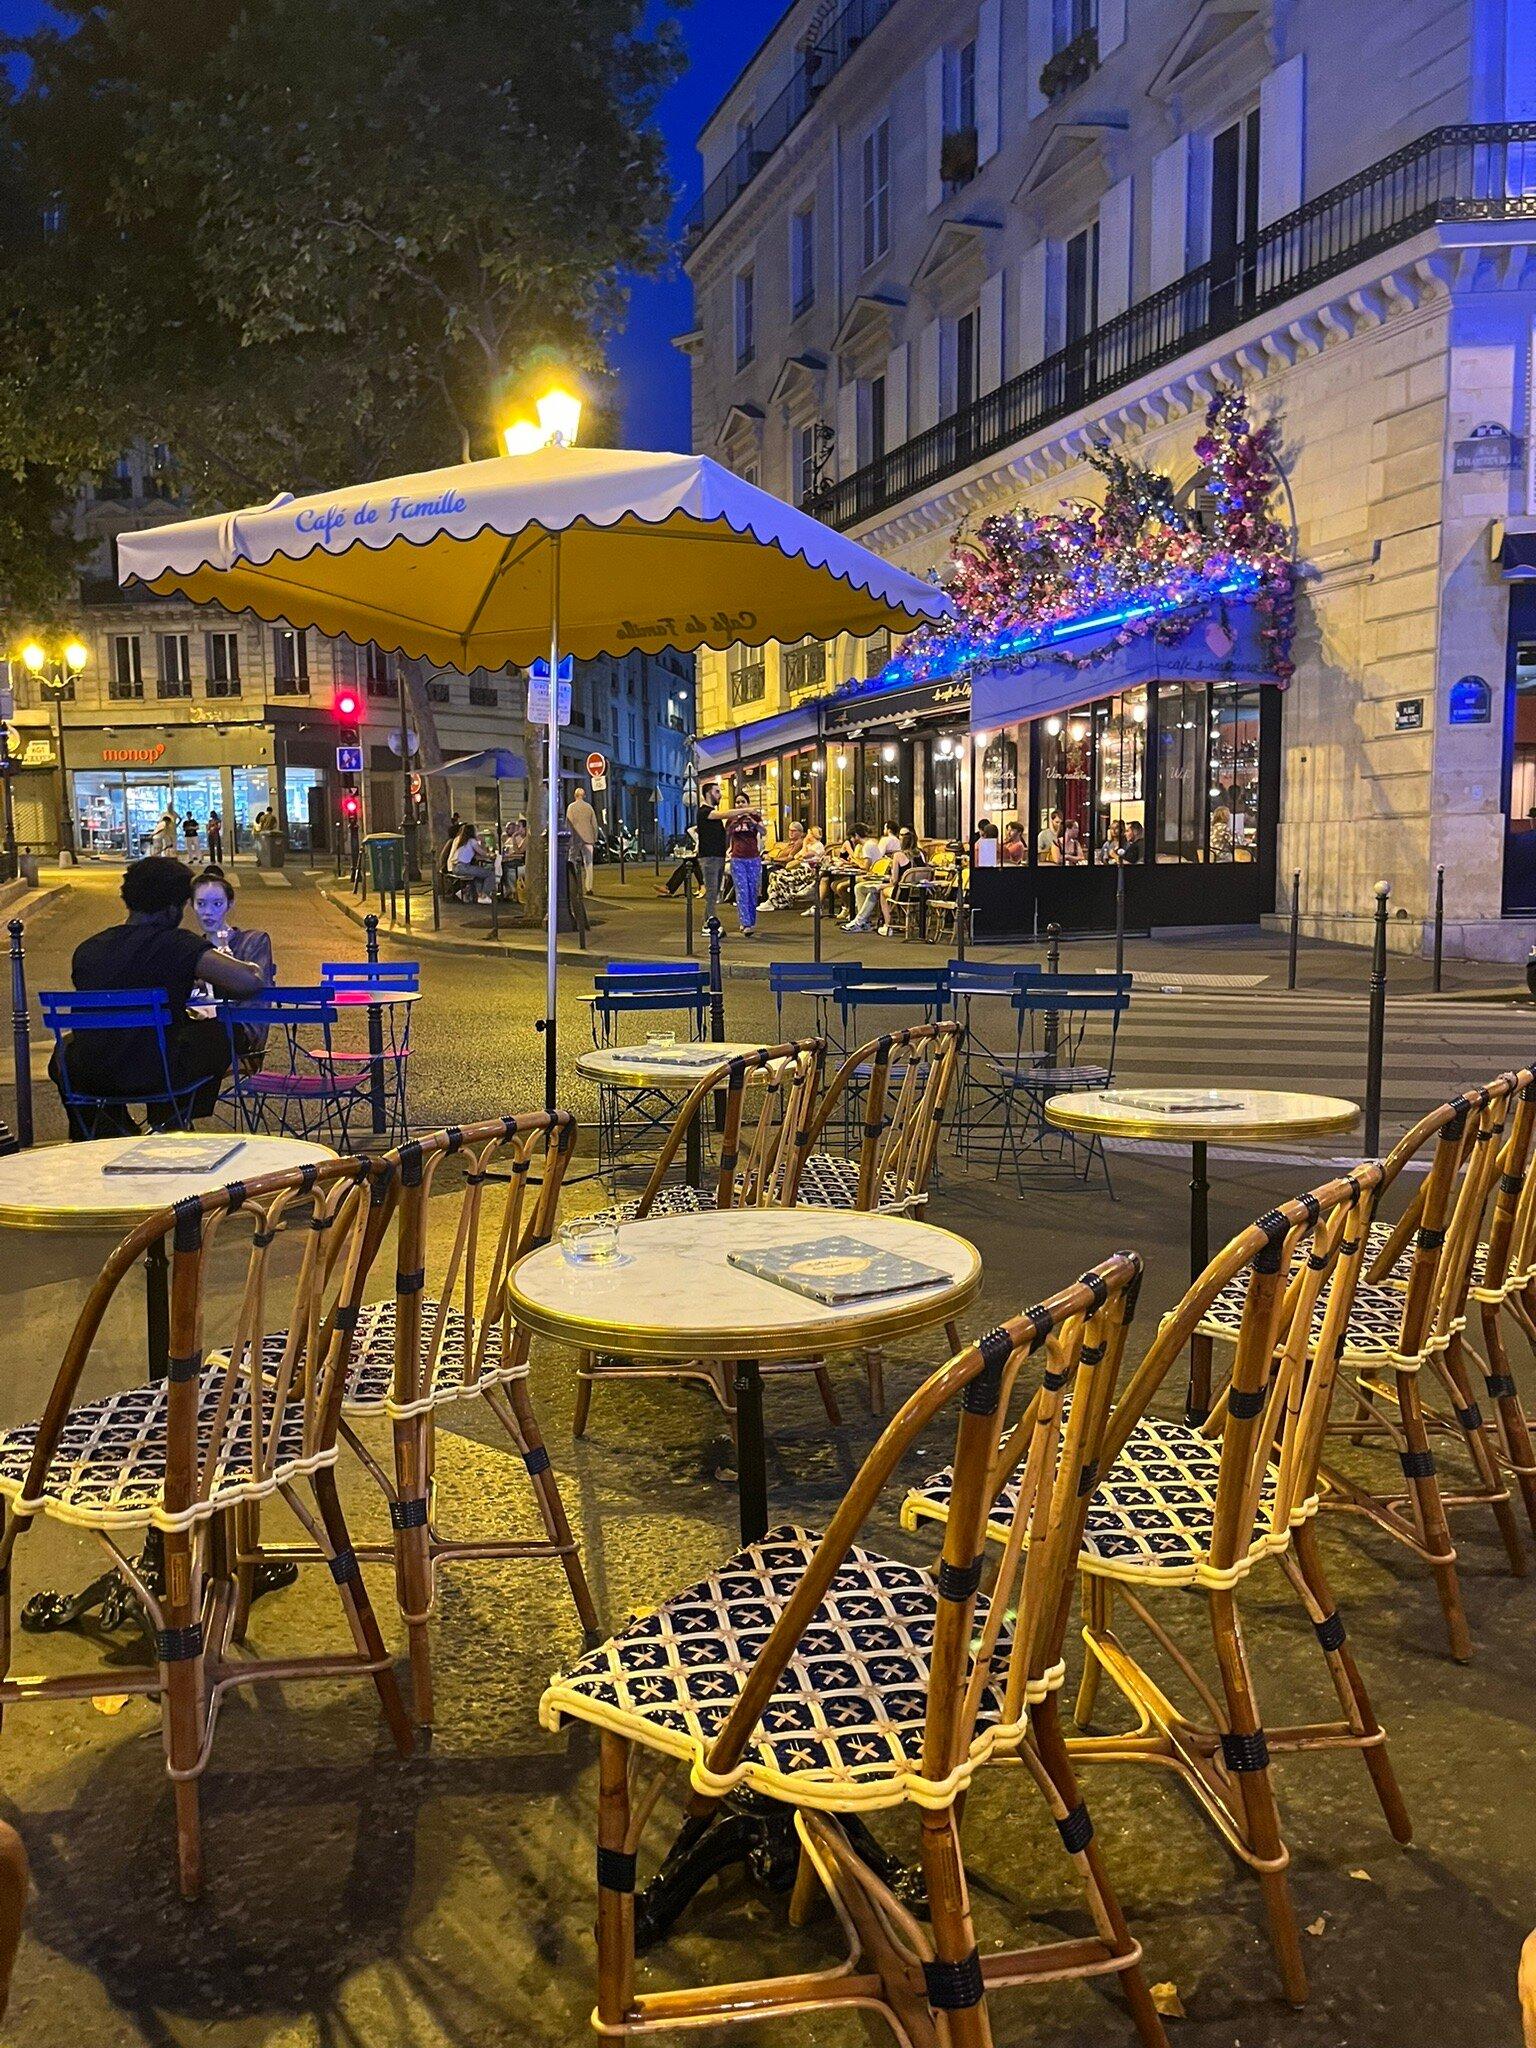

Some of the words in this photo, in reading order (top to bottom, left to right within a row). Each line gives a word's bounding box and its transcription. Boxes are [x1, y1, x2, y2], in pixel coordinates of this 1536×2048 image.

[295, 503, 347, 544] Café
[353, 499, 379, 525] de
[388, 488, 467, 523] Famille
